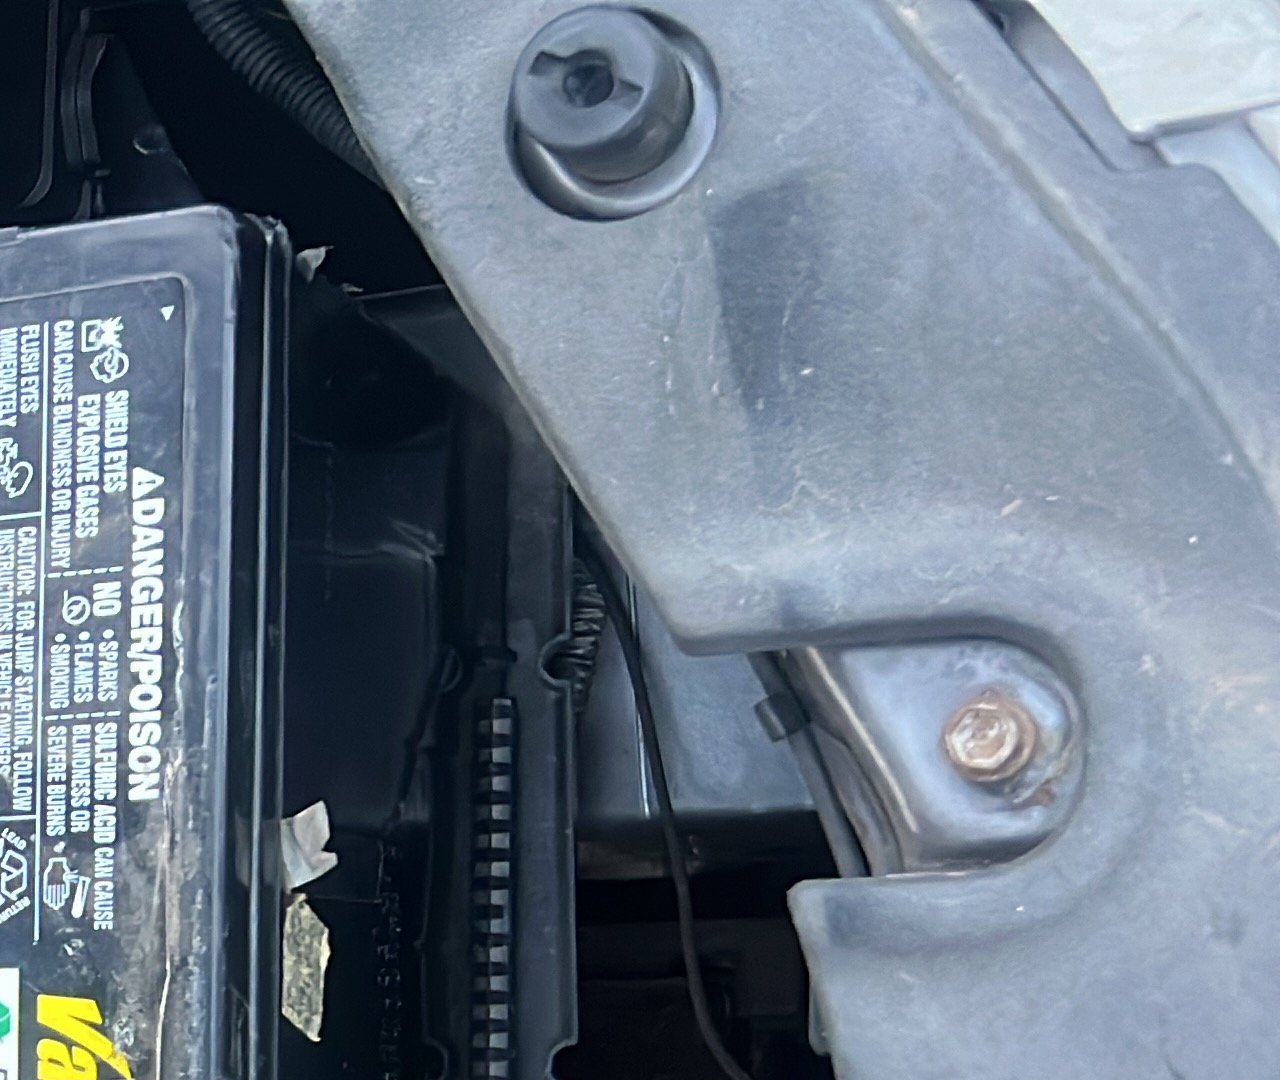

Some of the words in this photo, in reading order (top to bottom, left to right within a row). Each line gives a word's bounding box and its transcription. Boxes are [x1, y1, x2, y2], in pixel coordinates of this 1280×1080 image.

[20, 324, 40, 374] FLUSH
[53, 320, 74, 350] CAN
[20, 376, 40, 413] EYES
[52, 353, 73, 403] CAUSE
[76, 394, 100, 482] EXPLOSIVE
[104, 390, 129, 448] SHIELD
[52, 404, 72, 487] BLINDNESS
[103, 450, 127, 493] EYES
[51, 489, 72, 512] OR
[75, 485, 99, 538] GASES
[17, 526, 37, 596] CAUTION:
[50, 515, 71, 568] INJURY
[16, 601, 35, 630] FOR
[92, 582, 121, 617] NO
[15, 633, 35, 673] JUMP
[127, 498, 165, 800] DANGER/POISON
[12, 676, 34, 750] STARTING,
[47, 726, 67, 782] SEVERE
[71, 724, 91, 806] BLINDNESS
[93, 723, 115, 800] SULFURIC
[12, 752, 32, 811] FOLLOW
[46, 785, 67, 837] BURNS
[70, 810, 90, 832] OR
[93, 804, 115, 843] ACID
[1, 828, 27, 851] LEAD
[93, 847, 114, 878] CAN
[93, 881, 114, 931] CAUSE
